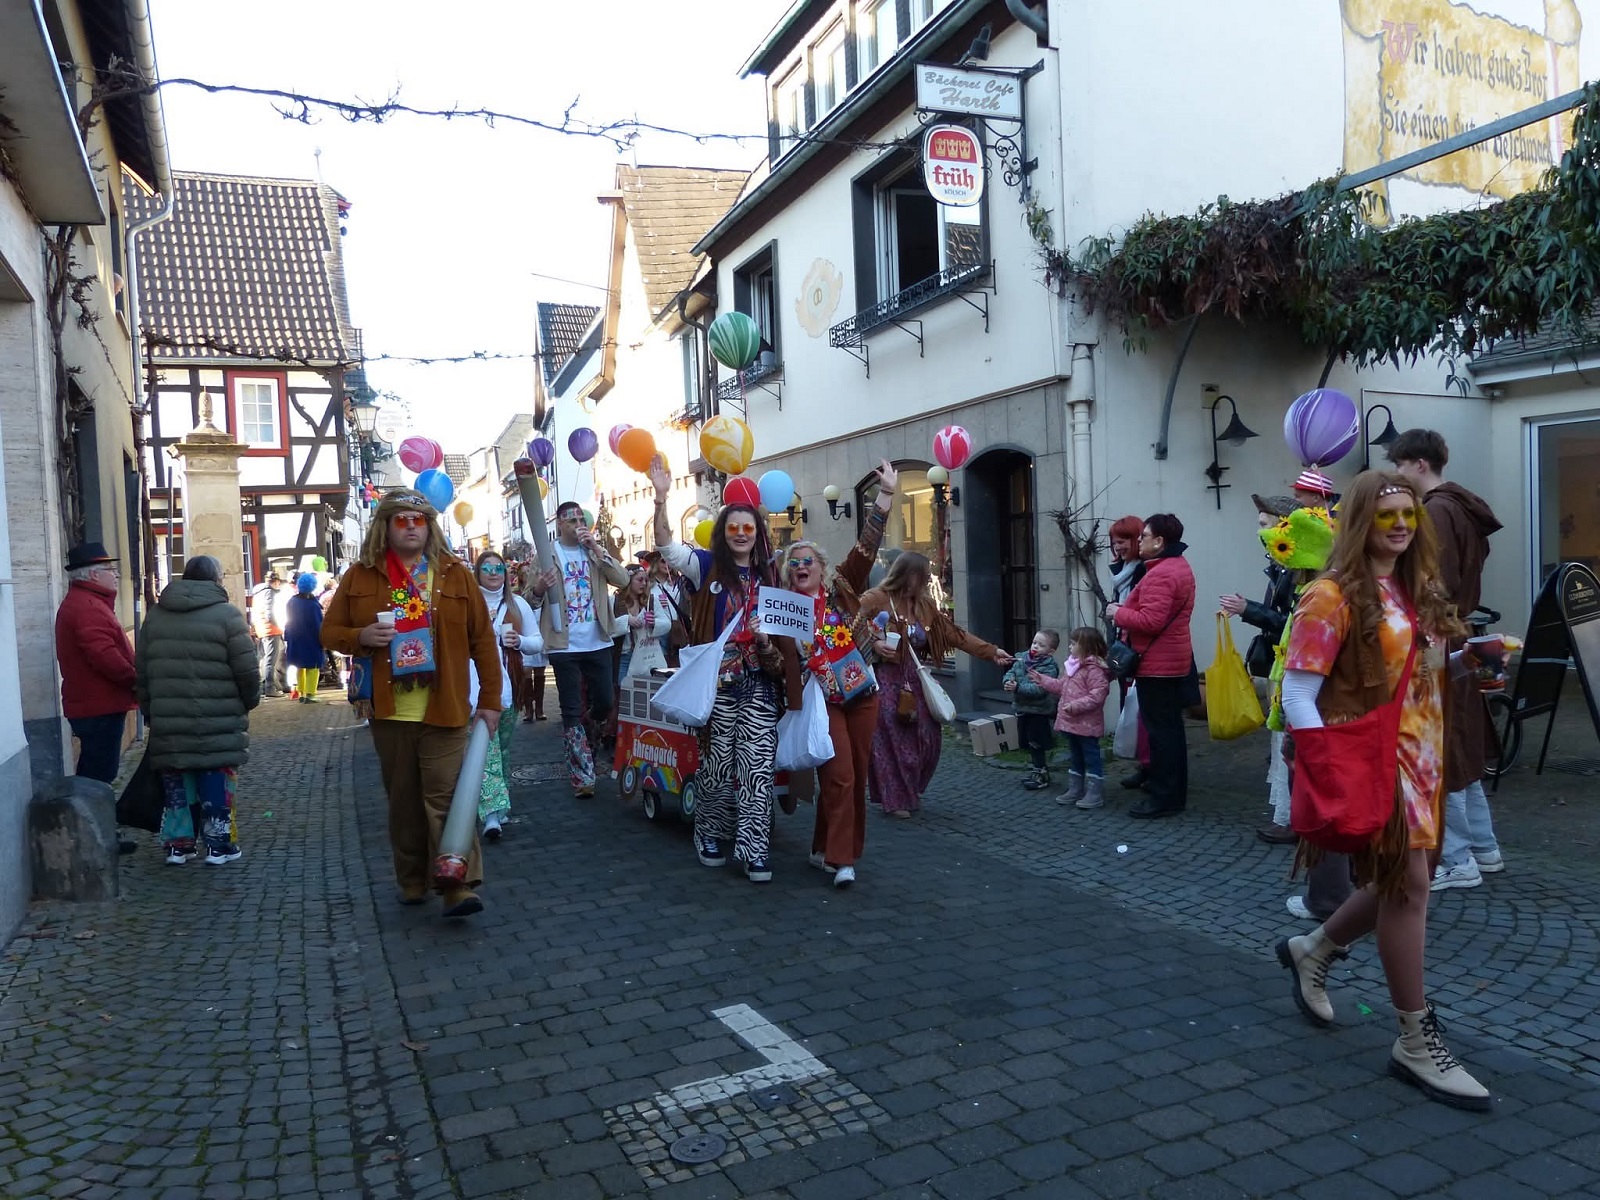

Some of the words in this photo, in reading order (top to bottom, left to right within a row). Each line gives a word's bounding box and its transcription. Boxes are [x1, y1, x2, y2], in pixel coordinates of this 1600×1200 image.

[1382, 21, 1428, 65] Wir
[1433, 31, 1483, 81] haben
[1487, 49, 1523, 91] gutes
[925, 71, 981, 89] Bäckerei
[939, 87, 1001, 111] Harth
[1383, 85, 1407, 136] Sie
[1410, 104, 1449, 140] einen
[932, 164, 974, 190] früh
[944, 188, 966, 196] KÖLSCH
[764, 598, 809, 618] SCHÖNE
[764, 613, 809, 632] GRUPPE
[632, 738, 678, 768] Ehrengarde
